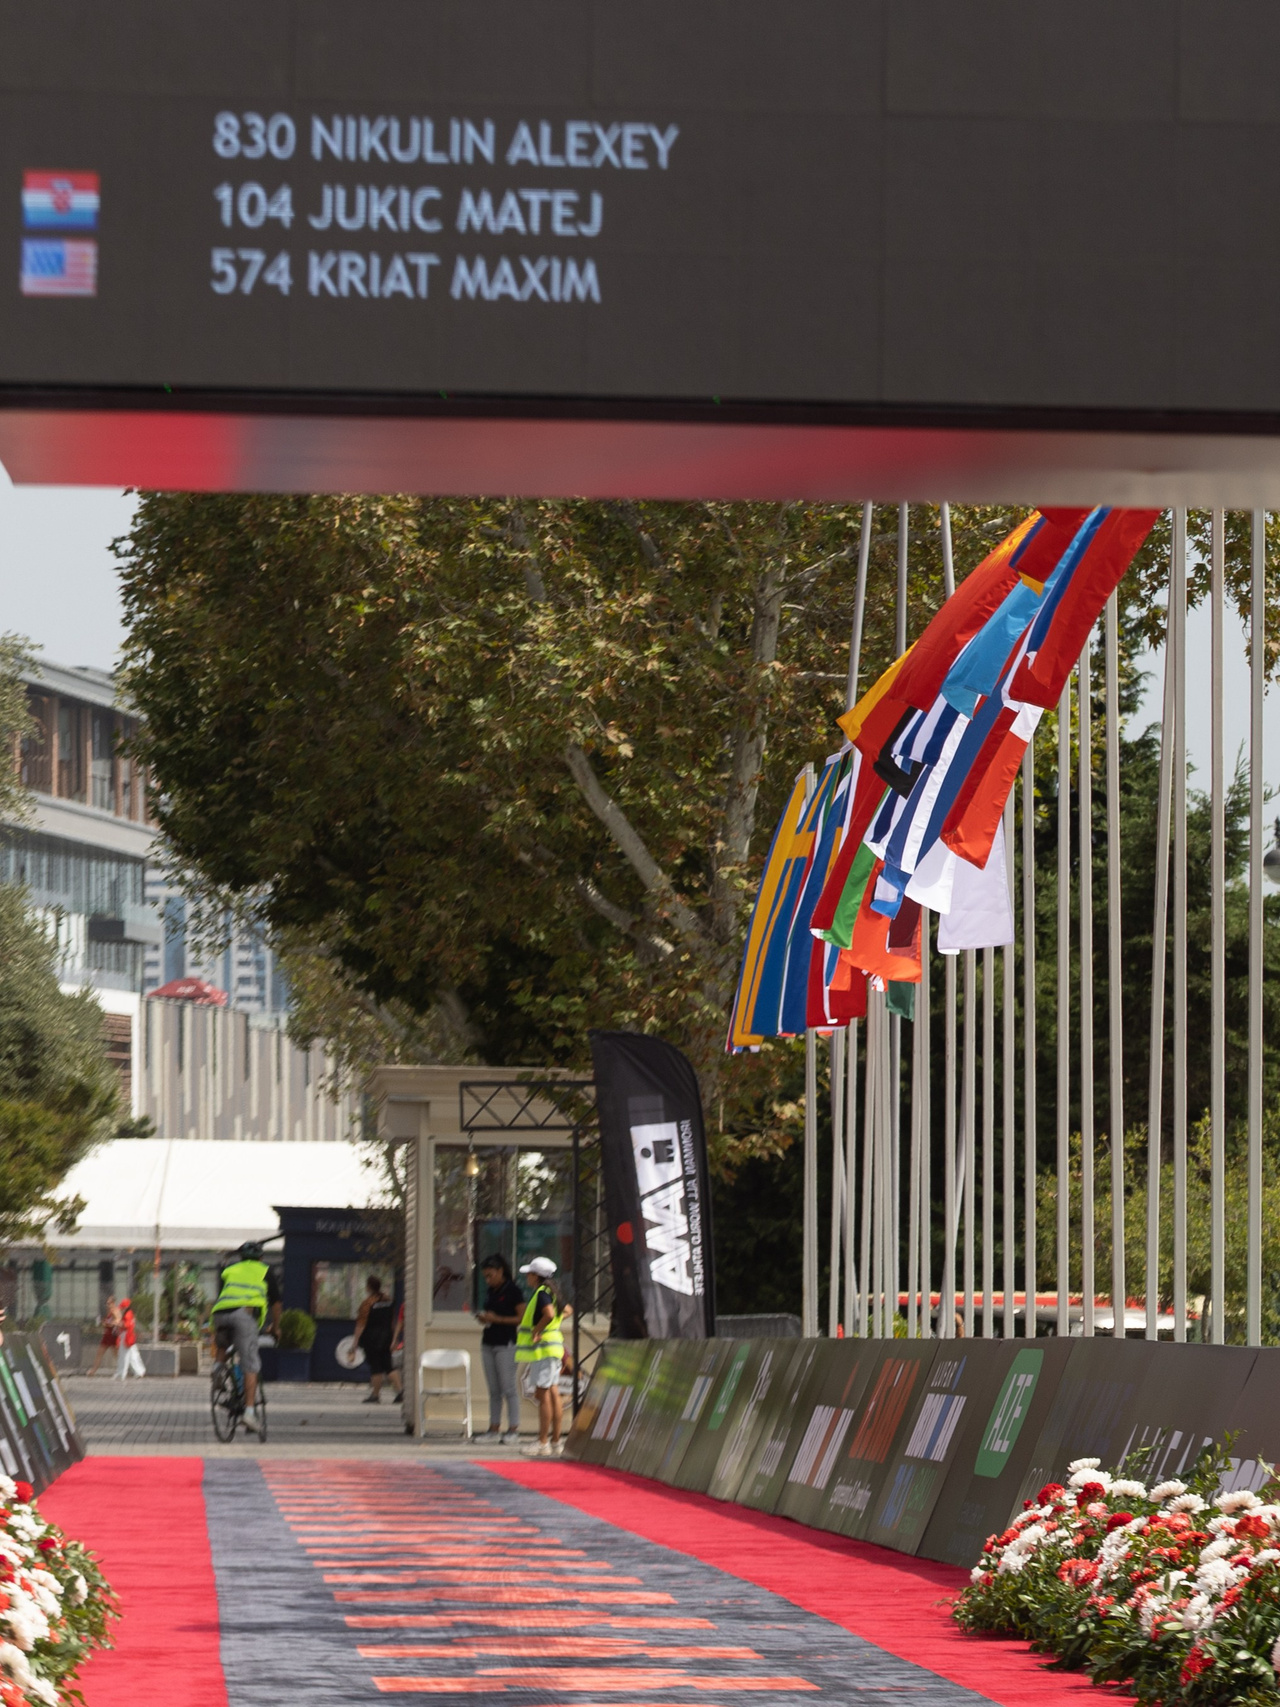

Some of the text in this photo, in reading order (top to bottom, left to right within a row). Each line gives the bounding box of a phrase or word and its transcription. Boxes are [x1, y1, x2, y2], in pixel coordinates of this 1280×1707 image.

[213, 111, 680, 169] 830 NIKULIN ALEXEY
[214, 182, 603, 237] 104 JUKIC MATEJ
[211, 248, 601, 303] 574 KRIAT MAXIM
[984, 1373, 1034, 1453] AZE
